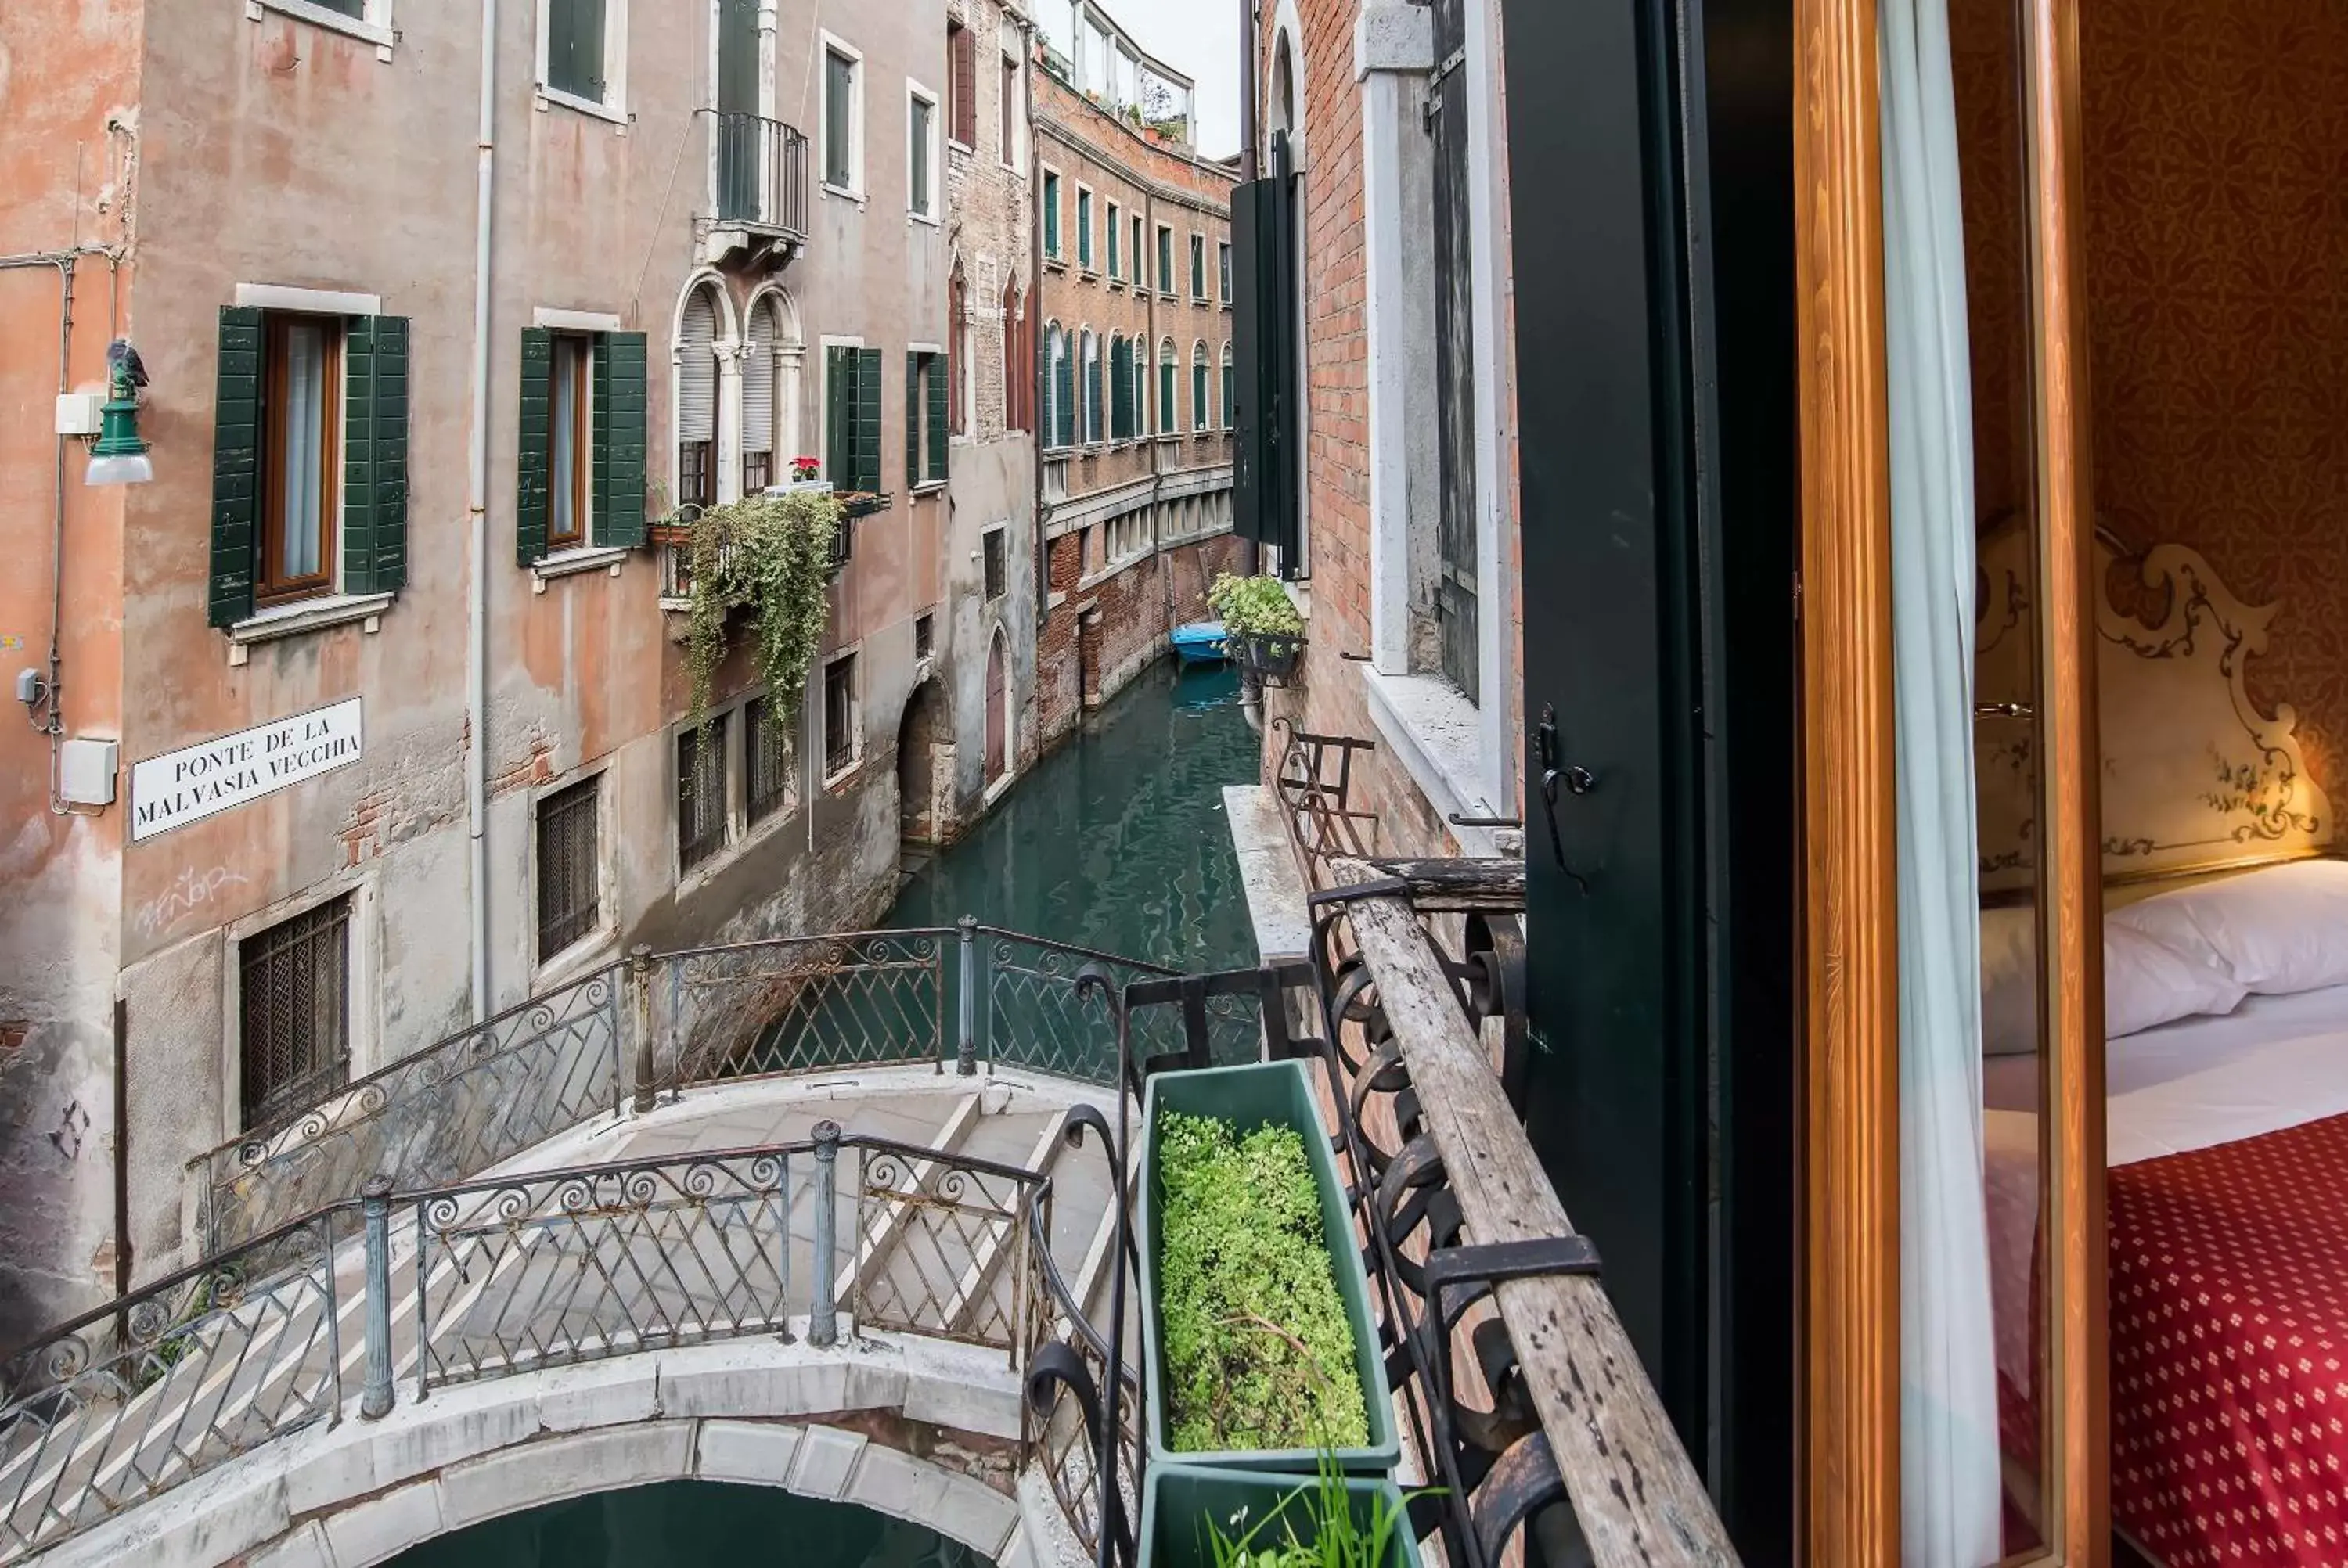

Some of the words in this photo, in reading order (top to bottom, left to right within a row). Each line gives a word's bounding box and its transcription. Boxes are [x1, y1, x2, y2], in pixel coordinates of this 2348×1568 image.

[137, 768, 259, 826] MALVASIA
[269, 735, 358, 779] VECCHIA
[175, 739, 254, 782] PONTE
[265, 727, 295, 753] DE
[304, 718, 330, 741] LA
